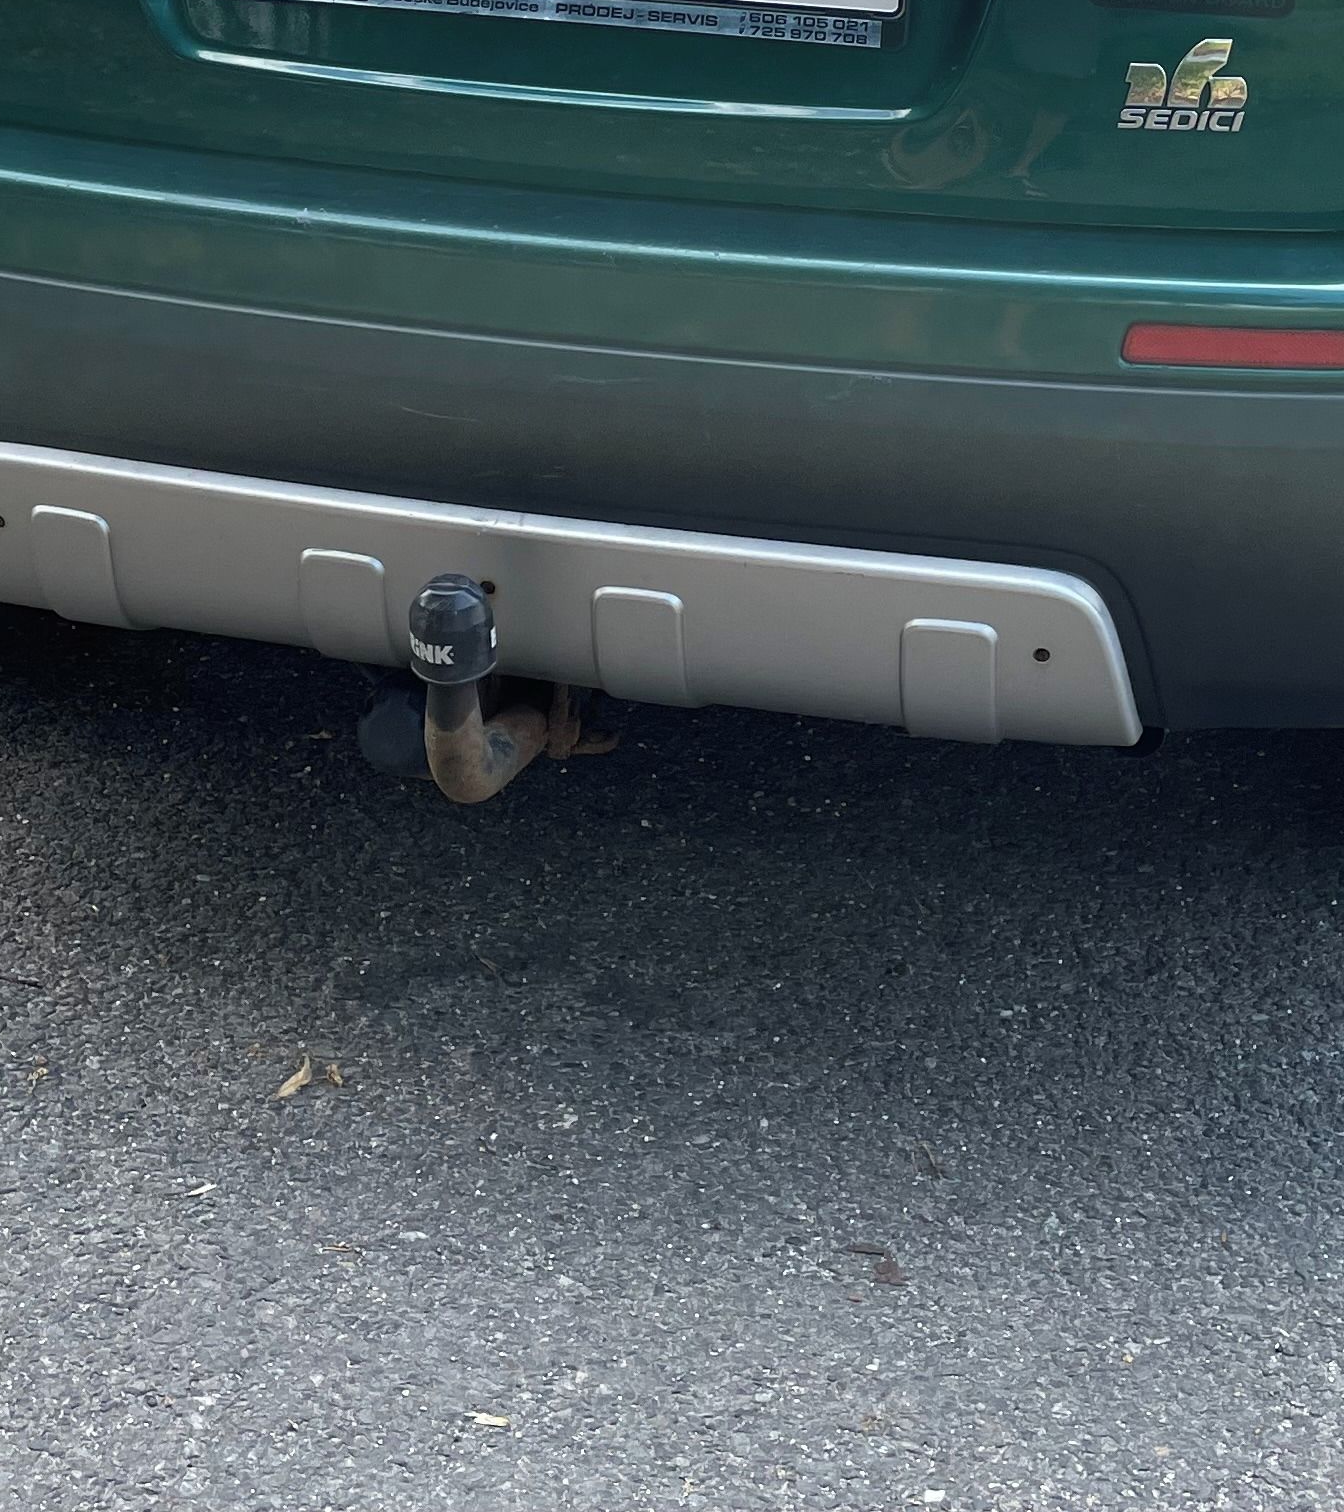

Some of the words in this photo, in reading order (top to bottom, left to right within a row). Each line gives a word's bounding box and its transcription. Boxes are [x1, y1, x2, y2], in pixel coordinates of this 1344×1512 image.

[749, 12, 787, 25] 606
[793, 16, 829, 28] 105
[832, 19, 869, 32] 021
[750, 25, 786, 38] 725
[790, 29, 827, 41] 970
[1117, 108, 1246, 133] SEDICI
